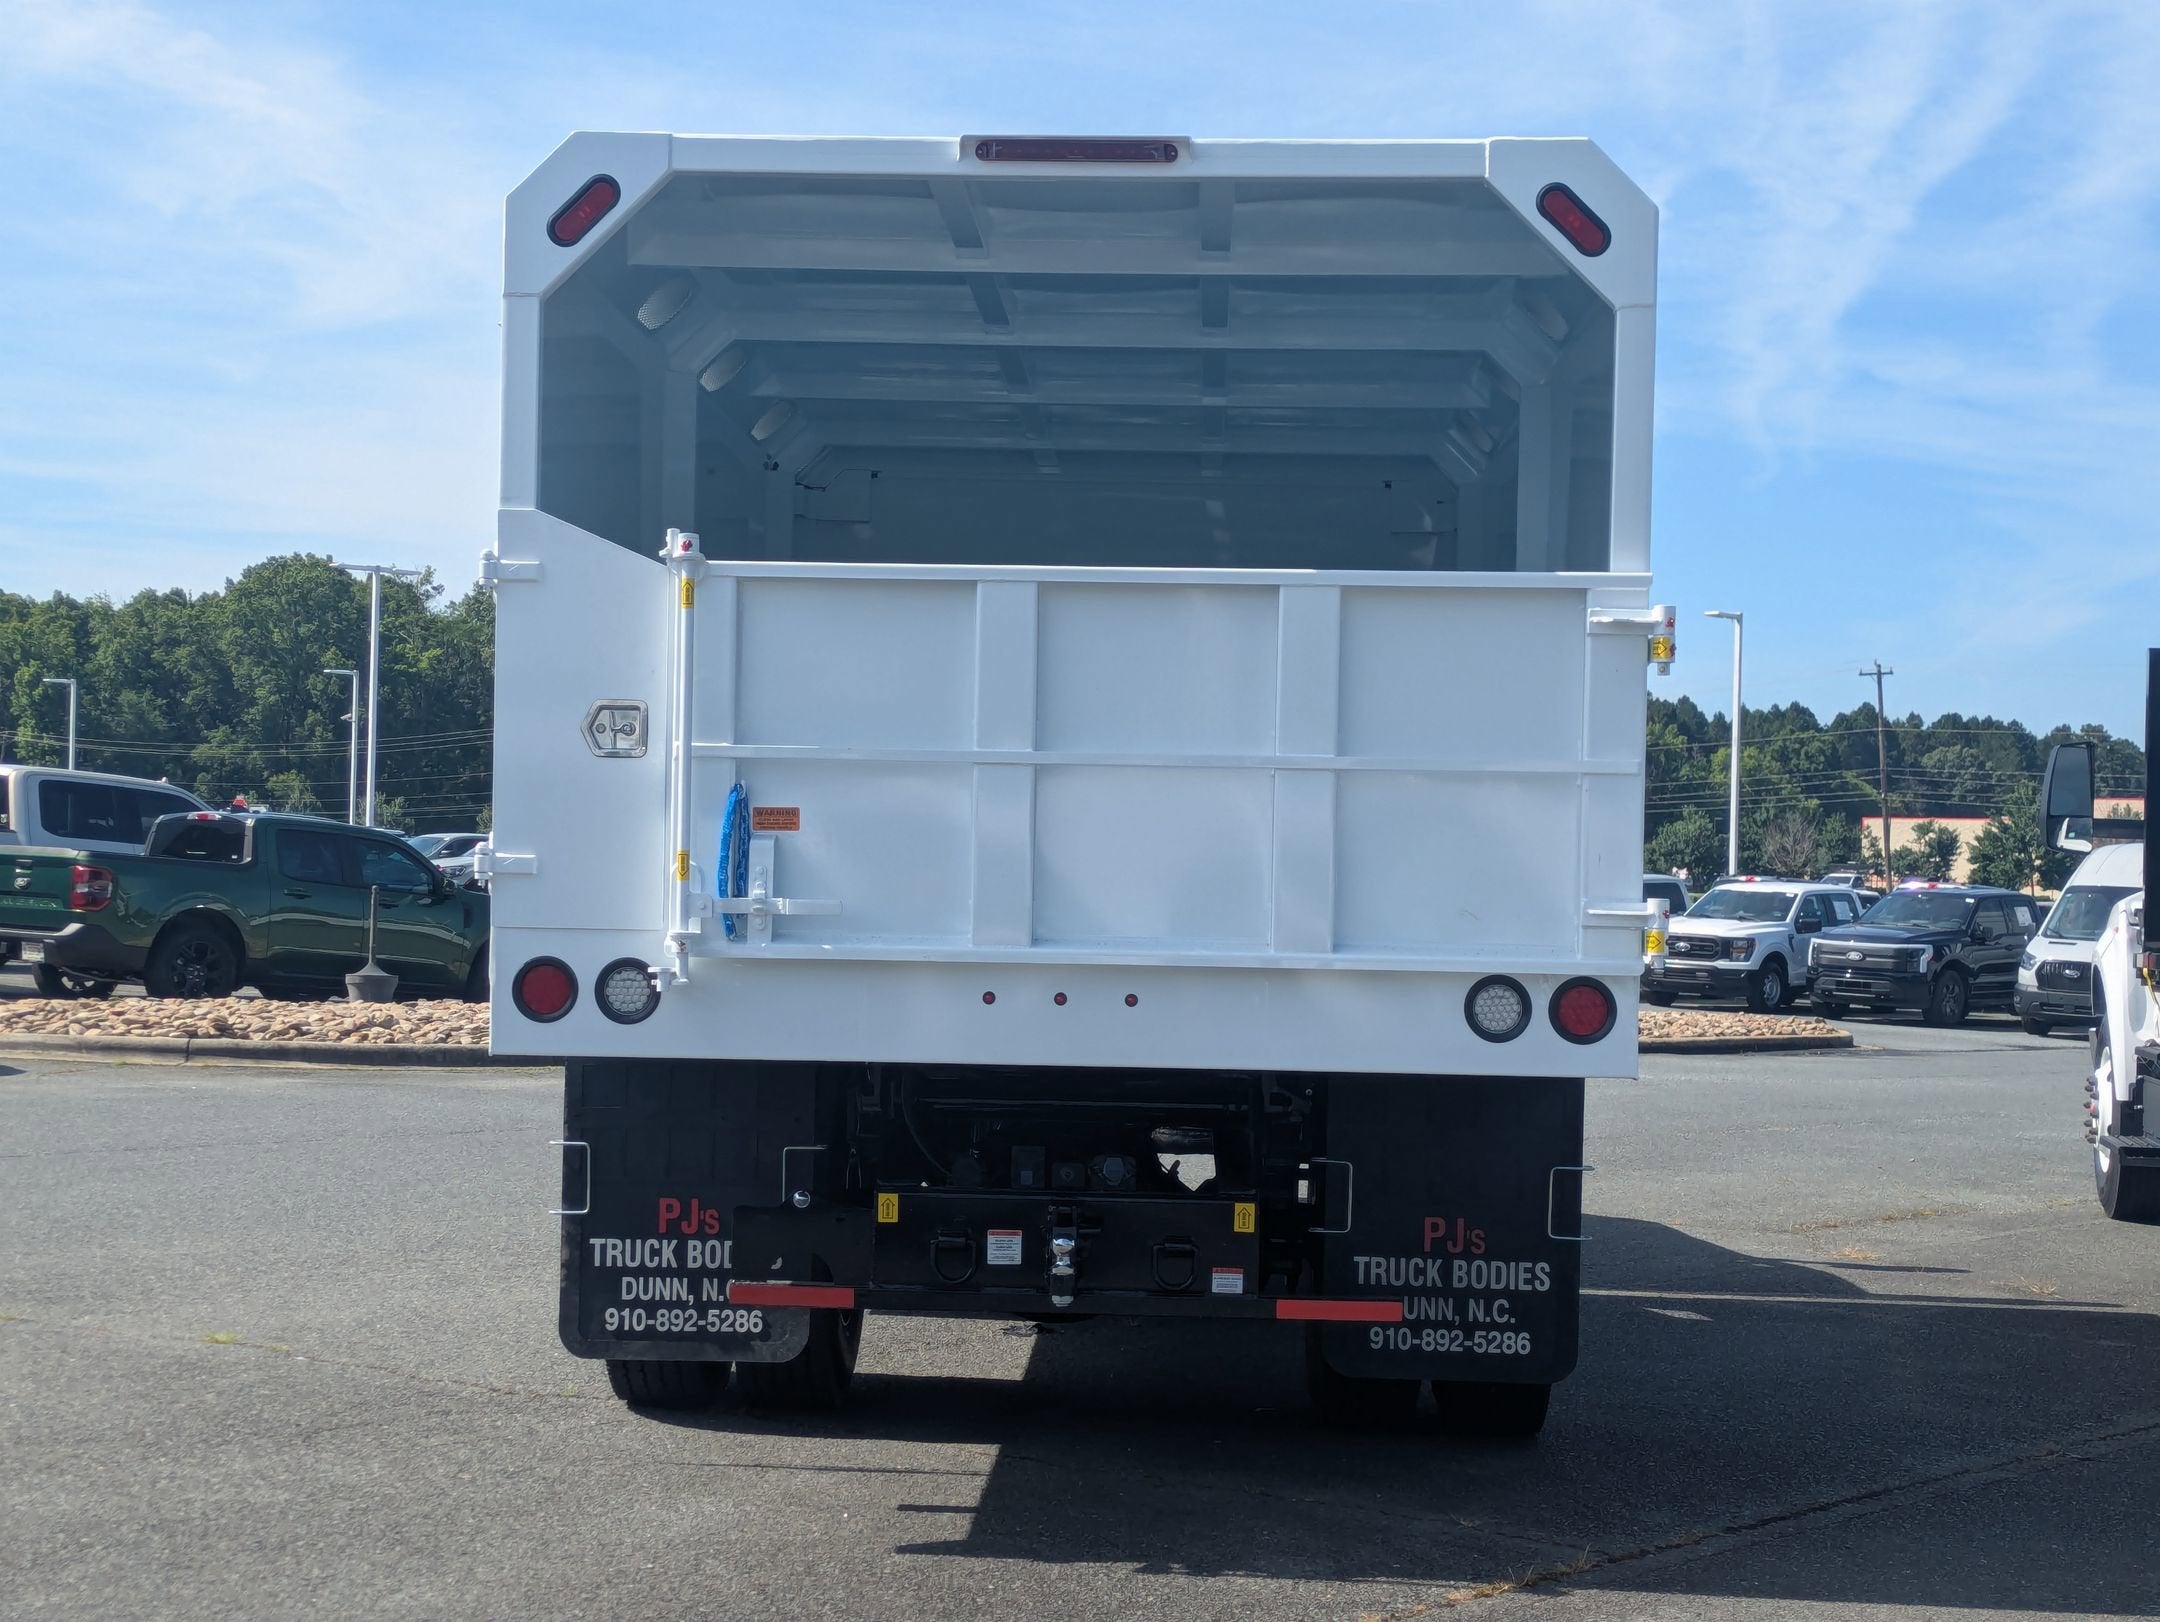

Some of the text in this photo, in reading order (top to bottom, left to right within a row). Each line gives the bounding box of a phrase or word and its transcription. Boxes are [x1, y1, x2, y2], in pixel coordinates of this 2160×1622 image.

[658, 1197, 720, 1235] PJ's
[1423, 1216, 1486, 1255] PJ's
[589, 1238, 678, 1268] TRUCK
[1353, 1256, 1551, 1291] TRUCK BODIES
[621, 1277, 732, 1305] DUNN, N.
[604, 1307, 763, 1333] 910-892-5286
[1403, 1296, 1517, 1326] UNN, N.C.
[1369, 1326, 1531, 1355] 910-892-5286
